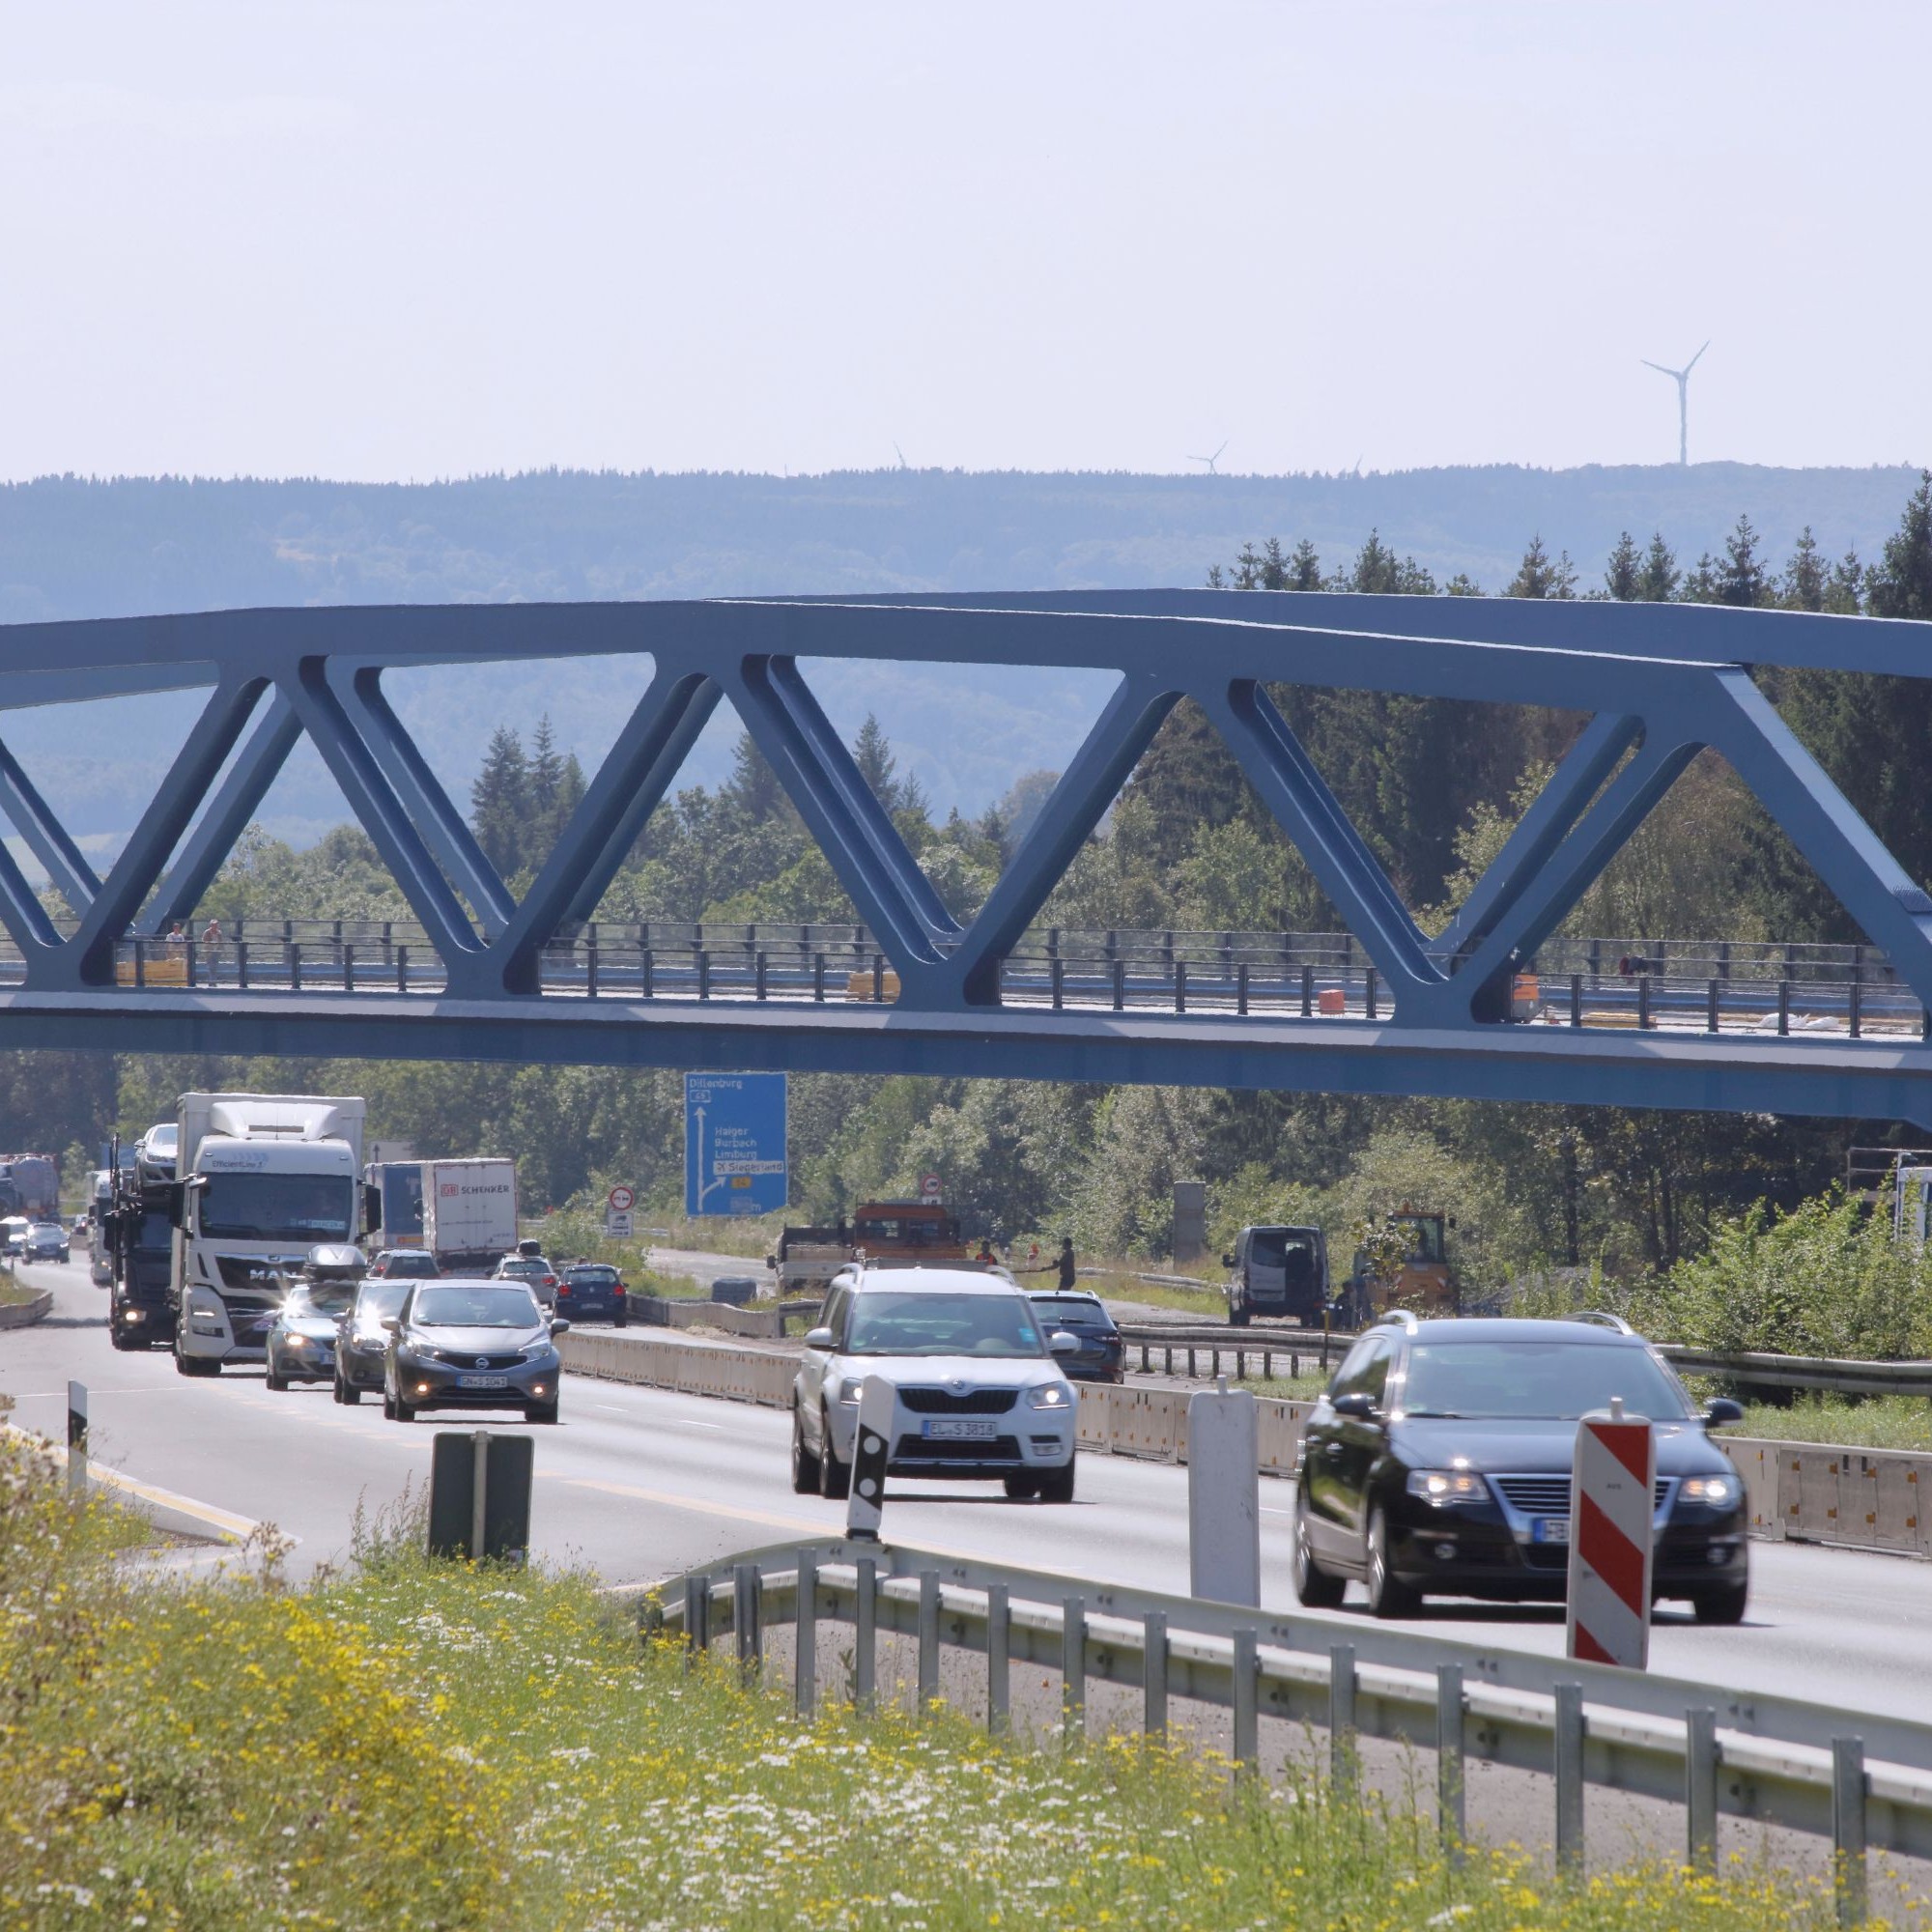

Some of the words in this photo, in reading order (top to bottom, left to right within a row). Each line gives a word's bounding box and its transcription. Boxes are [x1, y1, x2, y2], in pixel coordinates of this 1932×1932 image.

[690, 1078, 742, 1090] Dillenburg
[715, 1127, 749, 1137] Haiger
[715, 1138, 757, 1148] Burbach
[715, 1150, 757, 1160] Limburg
[461, 1184, 510, 1195] SCHENKER
[249, 1268, 298, 1280] MAN
